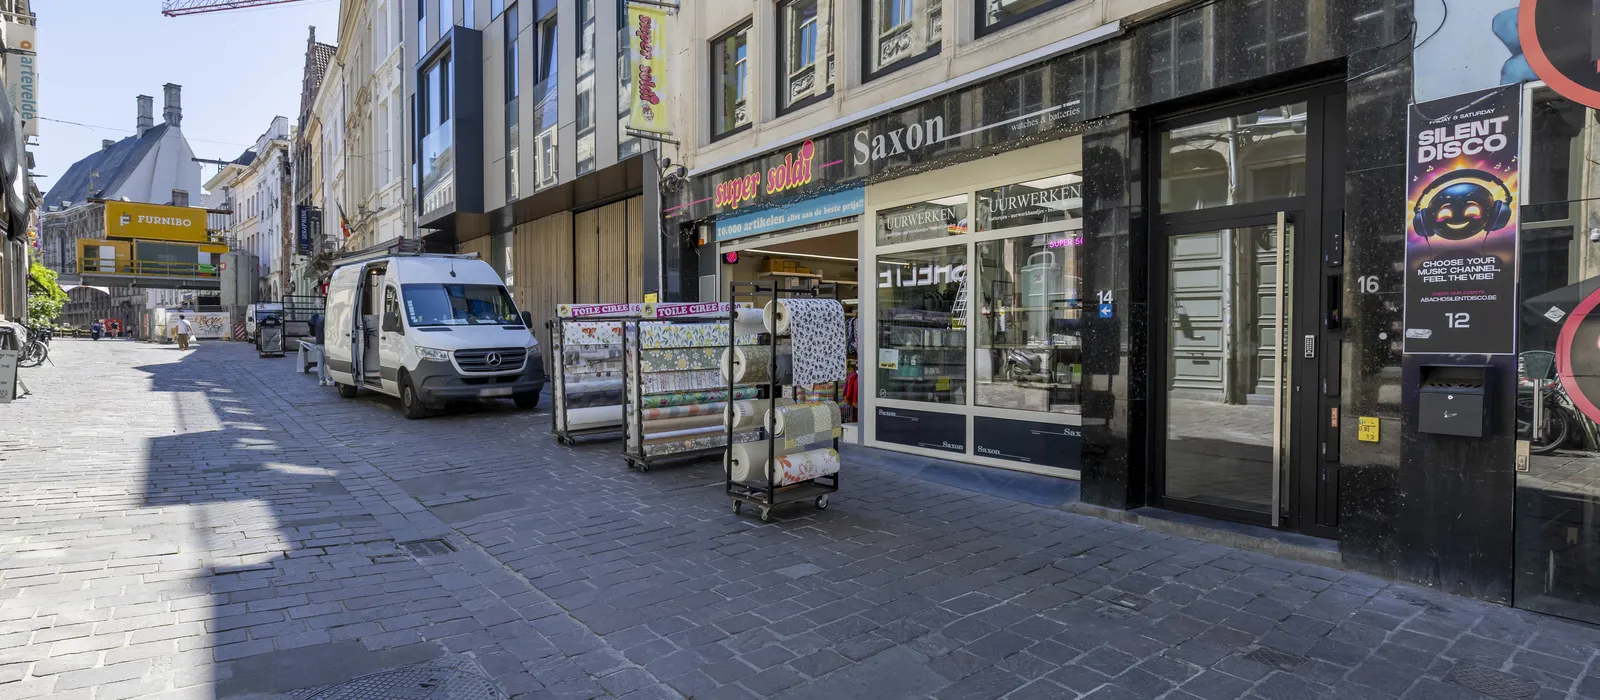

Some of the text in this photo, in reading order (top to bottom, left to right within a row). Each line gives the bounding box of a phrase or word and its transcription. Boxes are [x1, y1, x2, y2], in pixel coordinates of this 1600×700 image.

[636, 14, 660, 105] super soldi
[20, 56, 36, 120] artevelde
[1460, 108, 1496, 119] SATURDAY
[1011, 118, 1039, 131] watches
[1041, 116, 1047, 124] &
[1418, 115, 1509, 146] SILENT
[853, 115, 944, 167] Saxon
[1418, 133, 1507, 164] DISCO
[715, 139, 815, 210] super soldi
[987, 184, 1082, 213] UURWERKEN
[138, 215, 192, 227] FURNIBO
[717, 223, 742, 237] 10.000
[744, 214, 785, 231] artikelen
[787, 213, 801, 222] alles
[802, 211, 813, 219] aan
[814, 208, 822, 216] de
[823, 204, 841, 214] beste
[887, 207, 956, 230] UURWERKEN
[1049, 239, 1073, 248] SUPER
[1423, 256, 1496, 268] CHOOSE YOUR
[1417, 265, 1501, 276] MUSIC CHANNEL,
[1423, 275, 1447, 283] FEEL
[1469, 272, 1494, 280] VIBE!
[1357, 275, 1380, 293] 16
[1096, 290, 1113, 304] 14
[572, 307, 600, 316] TOILE
[658, 306, 687, 316] TOILE
[1445, 312, 1470, 328] 12
[878, 409, 896, 417] Saxon
[1064, 428, 1082, 437] Sax
[942, 441, 964, 450] Saxon
[977, 445, 1000, 455] Saxon
